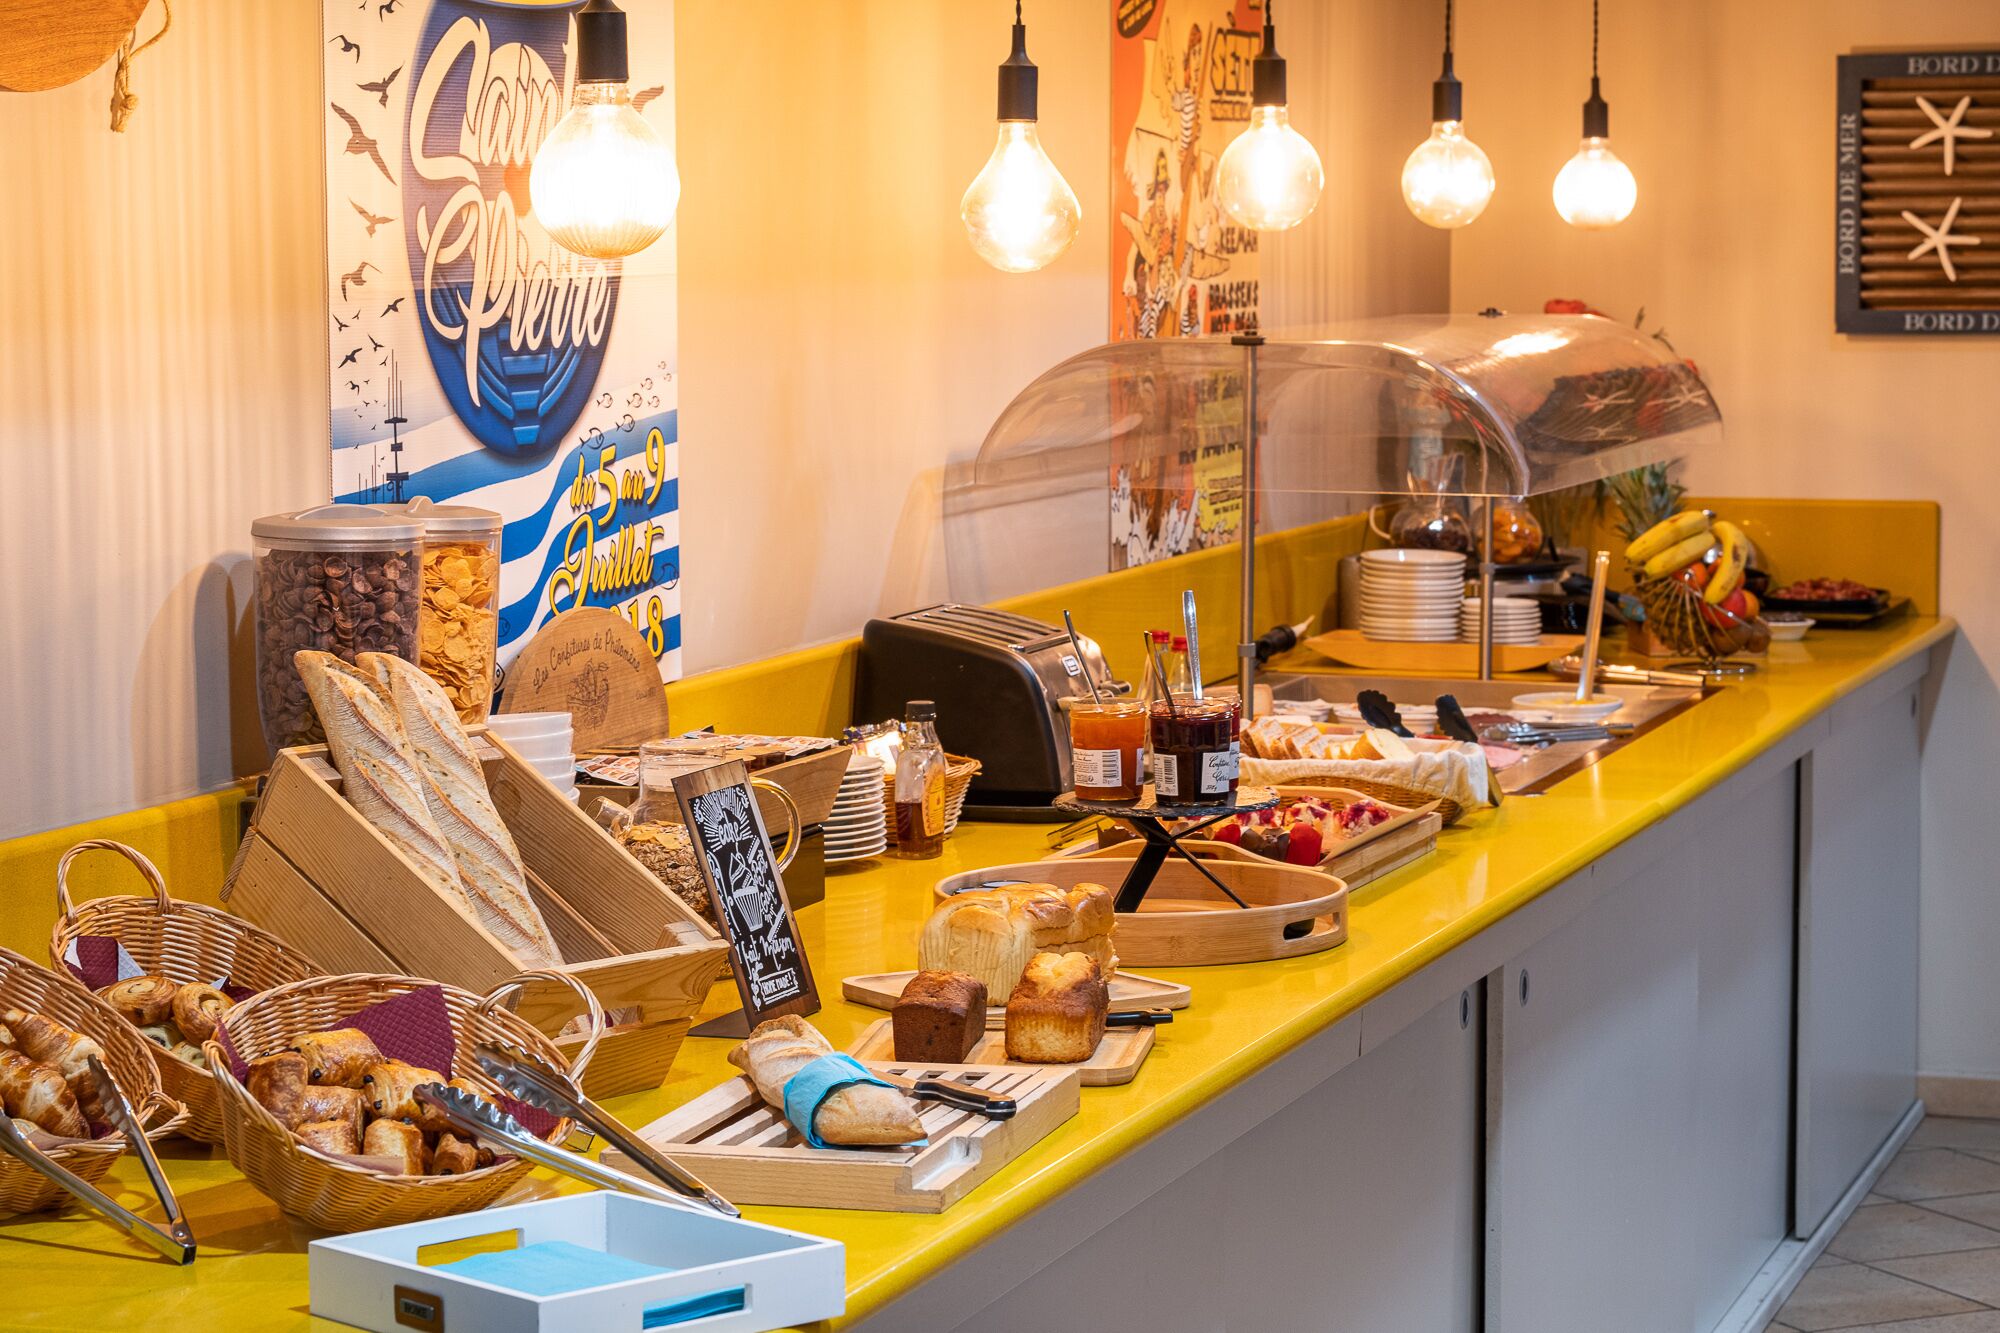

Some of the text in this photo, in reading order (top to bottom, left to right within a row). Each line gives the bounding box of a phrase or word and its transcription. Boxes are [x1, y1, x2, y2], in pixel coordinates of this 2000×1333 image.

[1908, 56, 1979, 75] BORD
[1839, 114, 1857, 274] BORD DE MER
[416, 182, 611, 406] Pierre
[1904, 313, 1975, 331] BORD
[570, 426, 665, 526] du 5 au 9
[550, 512, 664, 615] Juillet
[533, 628, 640, 694] Les Confitures de Philomène
[609, 595, 664, 658] 18
